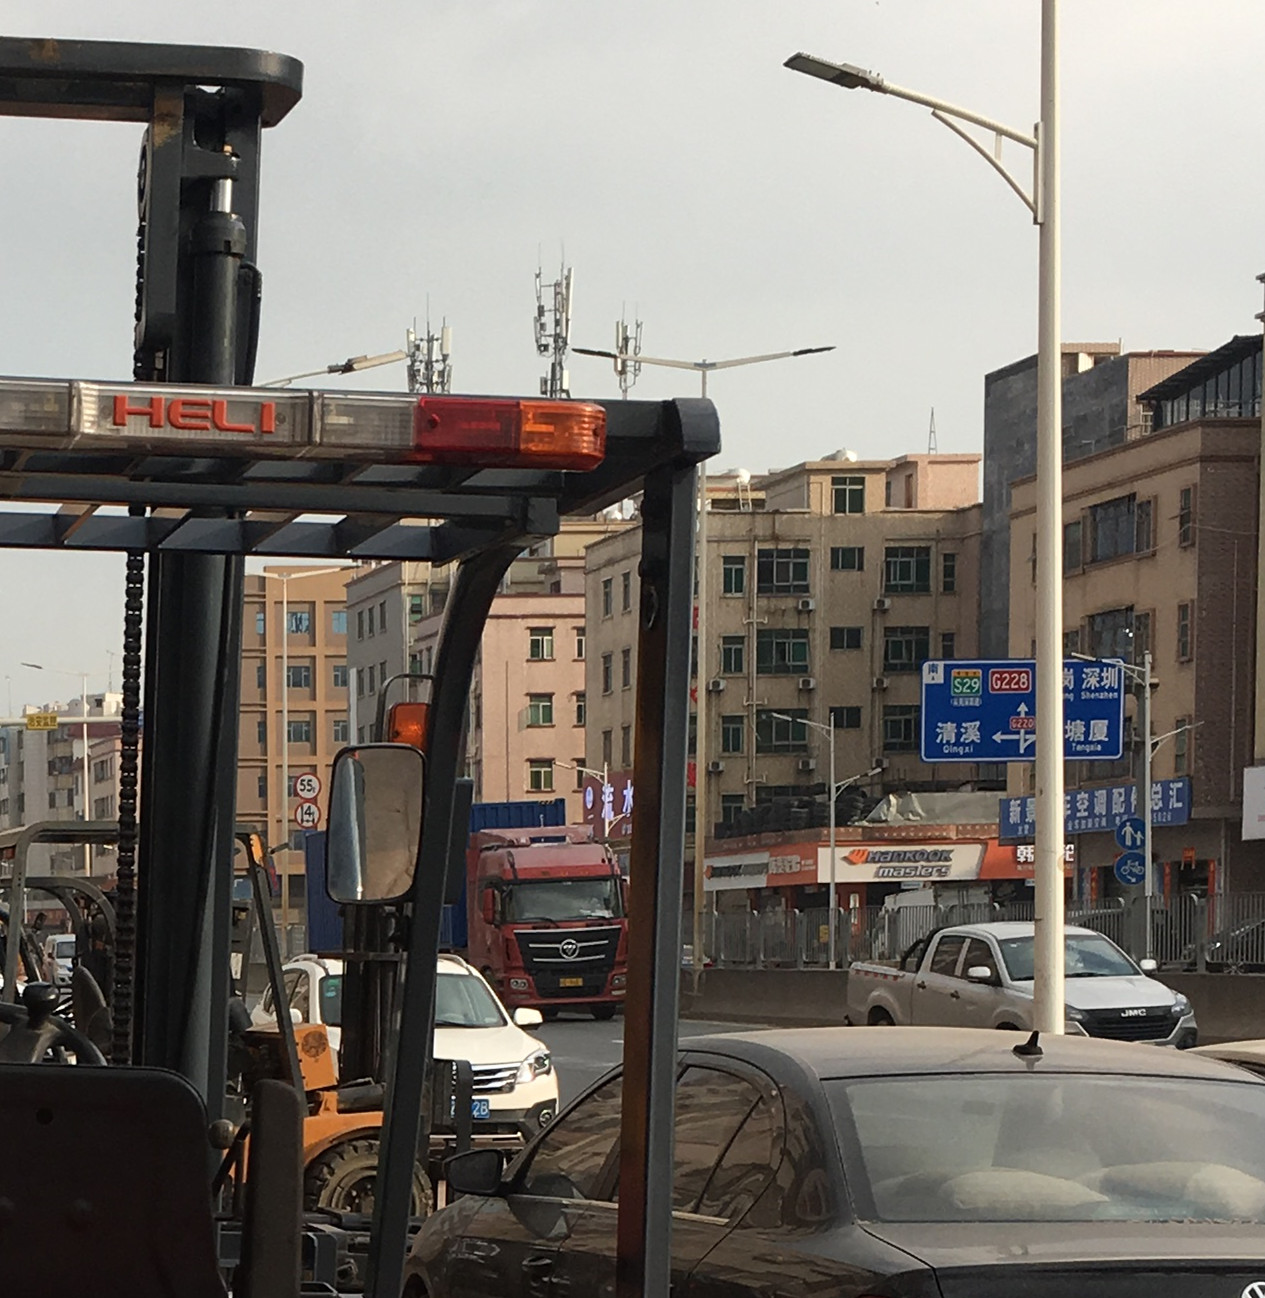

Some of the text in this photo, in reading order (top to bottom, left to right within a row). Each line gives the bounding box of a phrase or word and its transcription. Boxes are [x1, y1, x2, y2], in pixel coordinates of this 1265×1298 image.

[113, 395, 275, 433] HELI
[954, 678, 980, 693] S29
[992, 673, 1028, 689] G228
[1082, 666, 1119, 690] 深圳
[1081, 691, 1118, 699] Shenzhen
[936, 719, 1109, 744] 清溪 塘厦
[943, 745, 973, 755] Qingxi
[876, 865, 951, 878] masters
[1121, 1008, 1147, 1018] JMC
